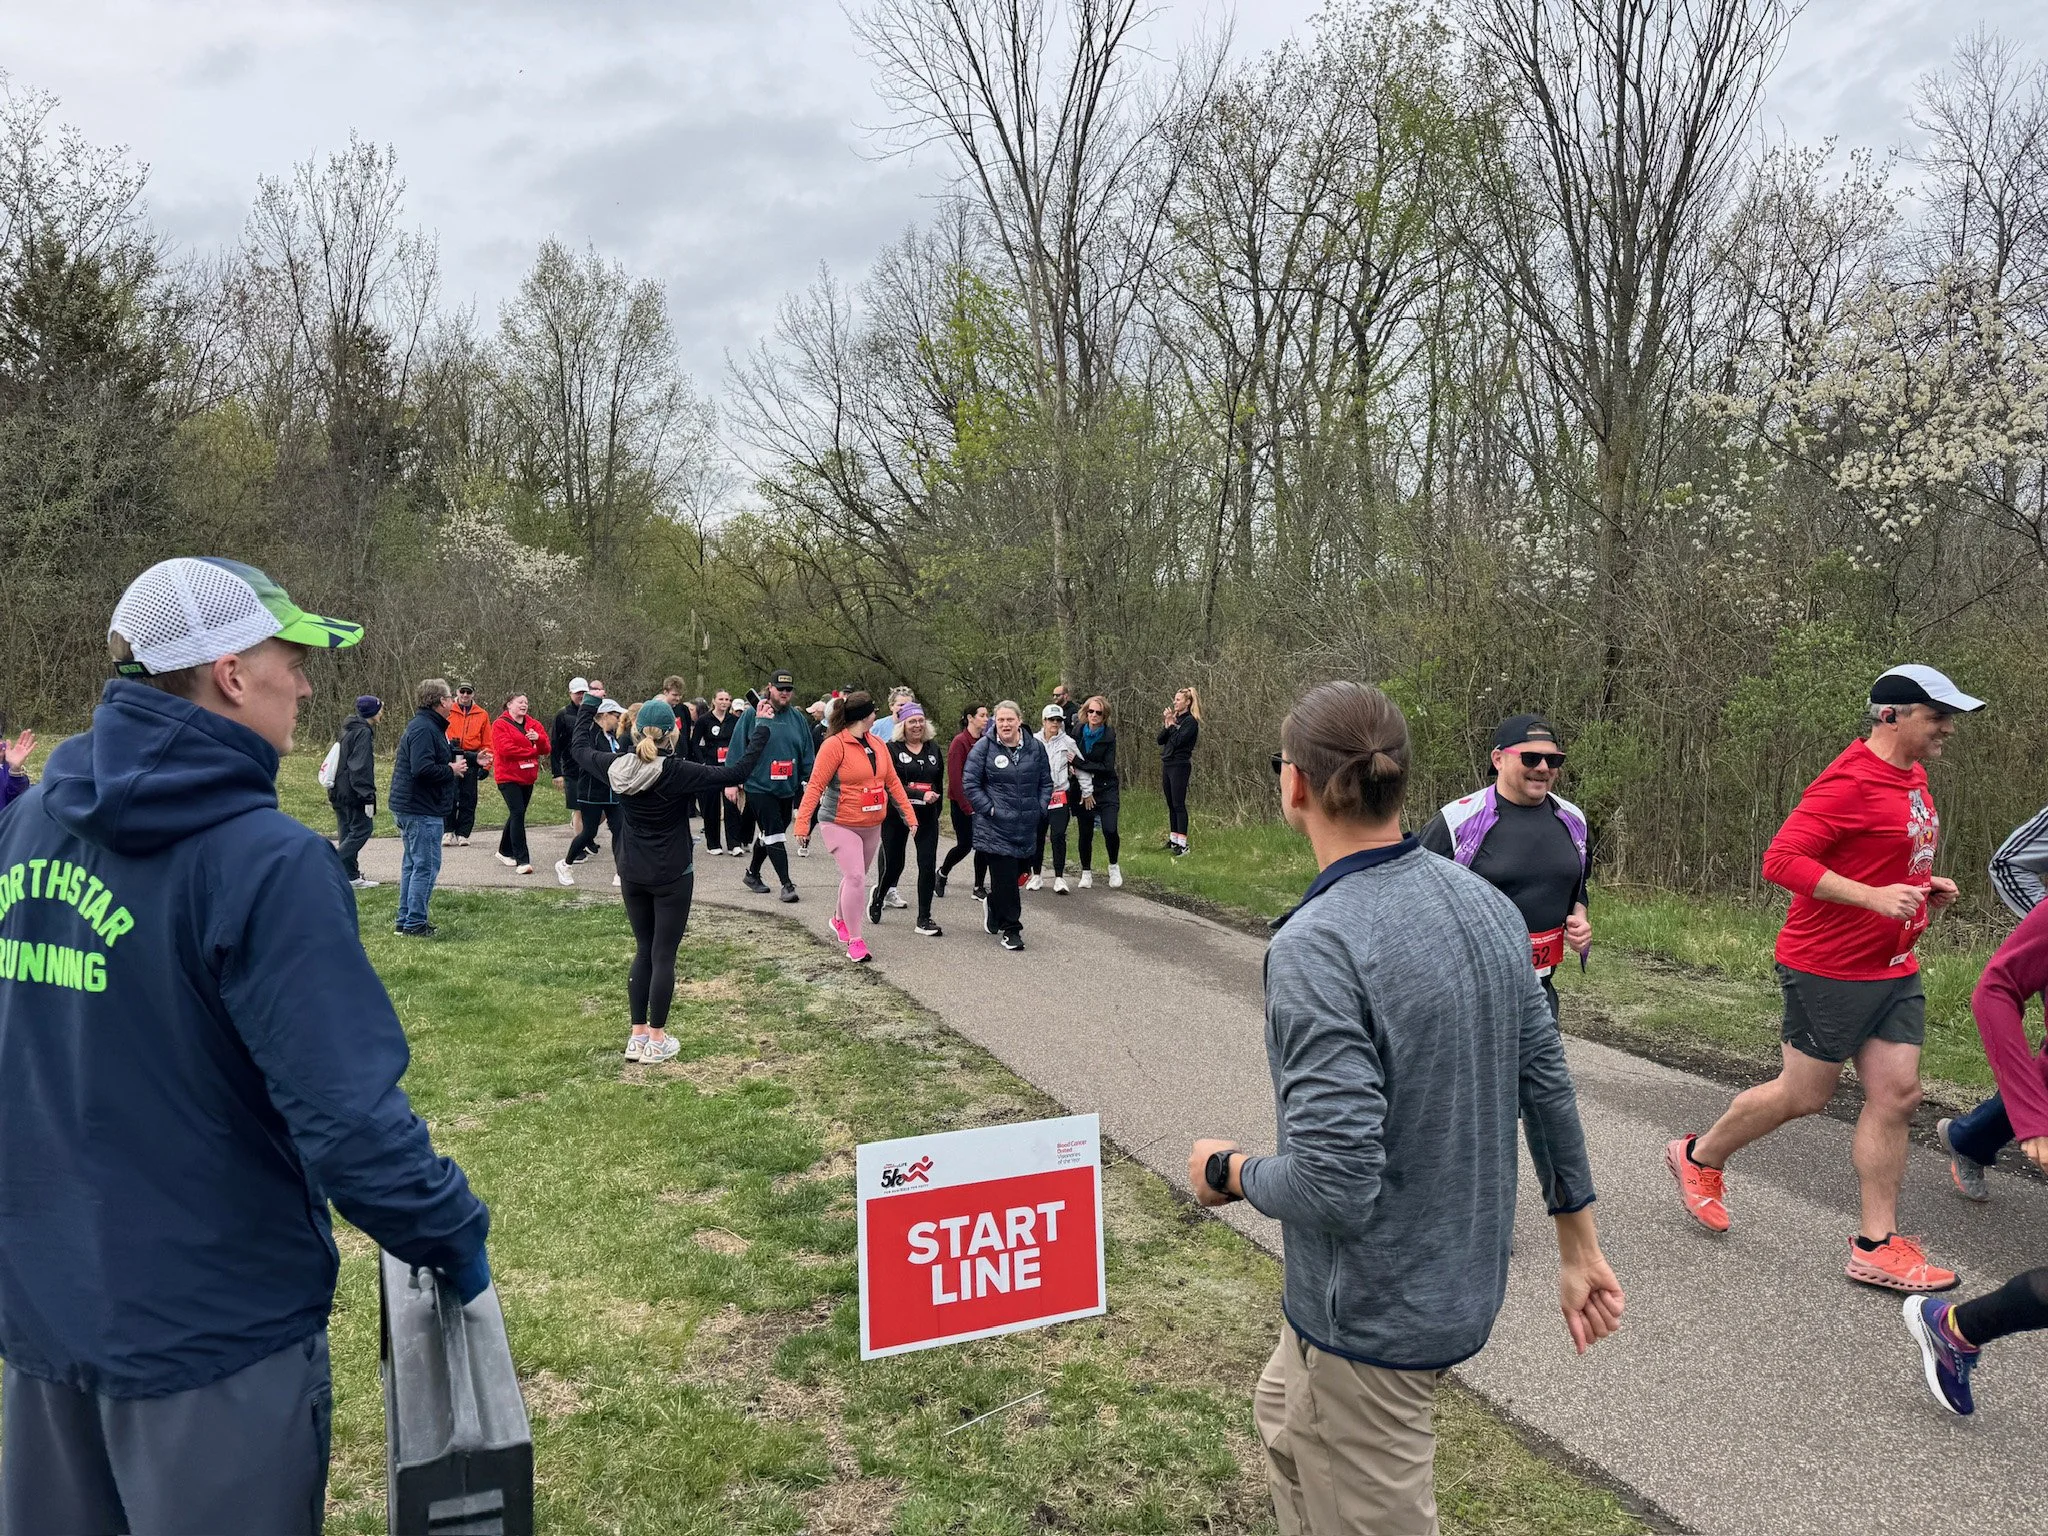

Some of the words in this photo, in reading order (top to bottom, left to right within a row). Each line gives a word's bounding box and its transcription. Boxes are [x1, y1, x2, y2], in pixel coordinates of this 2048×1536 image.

[873, 794, 879, 804] 3
[0, 859, 135, 948] ORTHSTAR
[1532, 945, 1550, 967] 52
[907, 1200, 1066, 1264] START
[931, 1247, 1042, 1306] LINE
